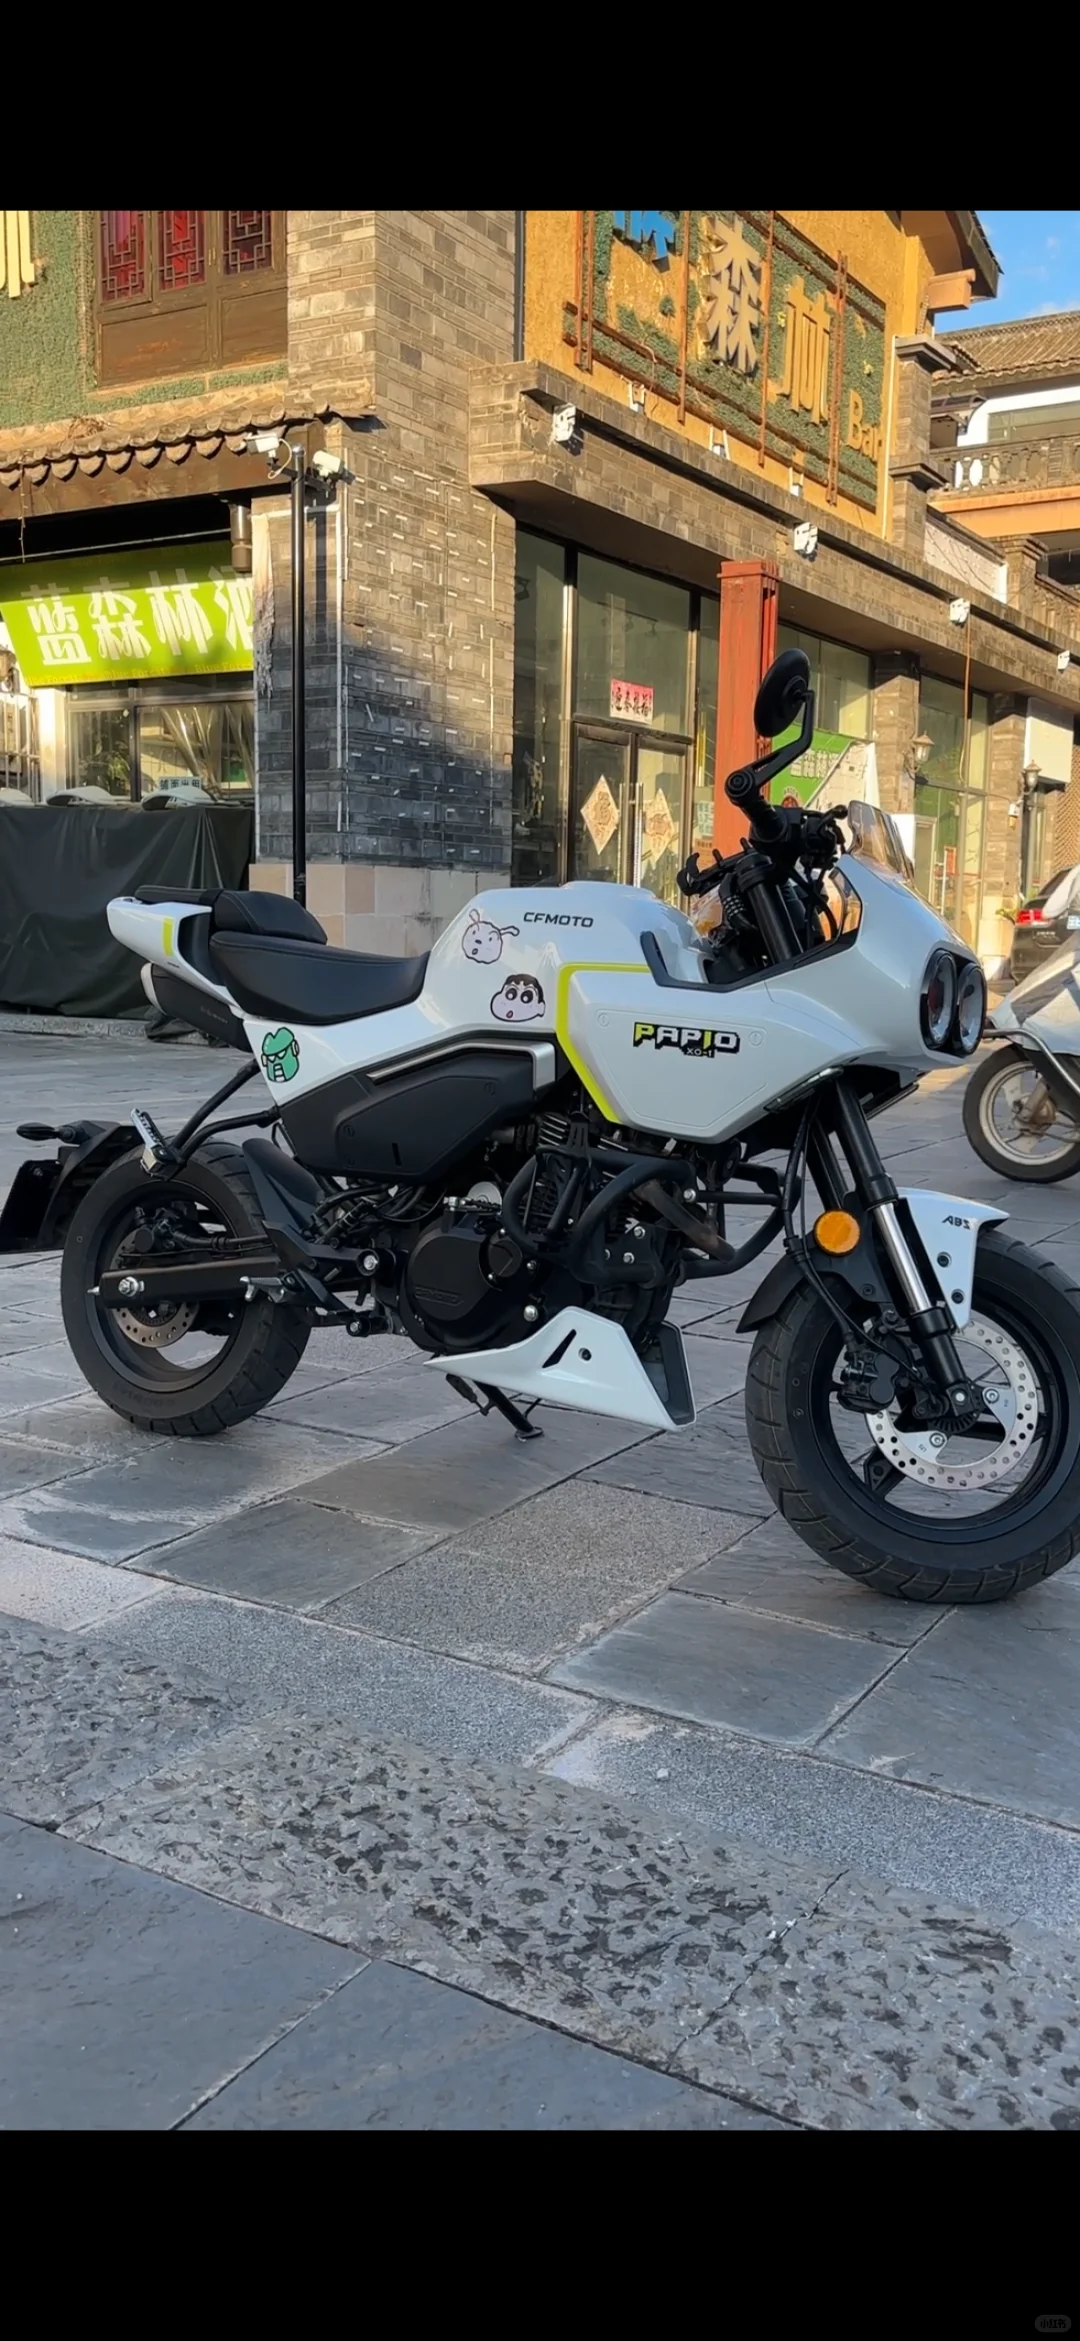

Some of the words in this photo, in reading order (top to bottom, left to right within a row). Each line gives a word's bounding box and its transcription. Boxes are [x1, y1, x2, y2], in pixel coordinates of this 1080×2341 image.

[523, 911, 594, 928] CFMOTO
[634, 1022, 740, 1053] PAPIO
[941, 1215, 970, 1230] ABS
